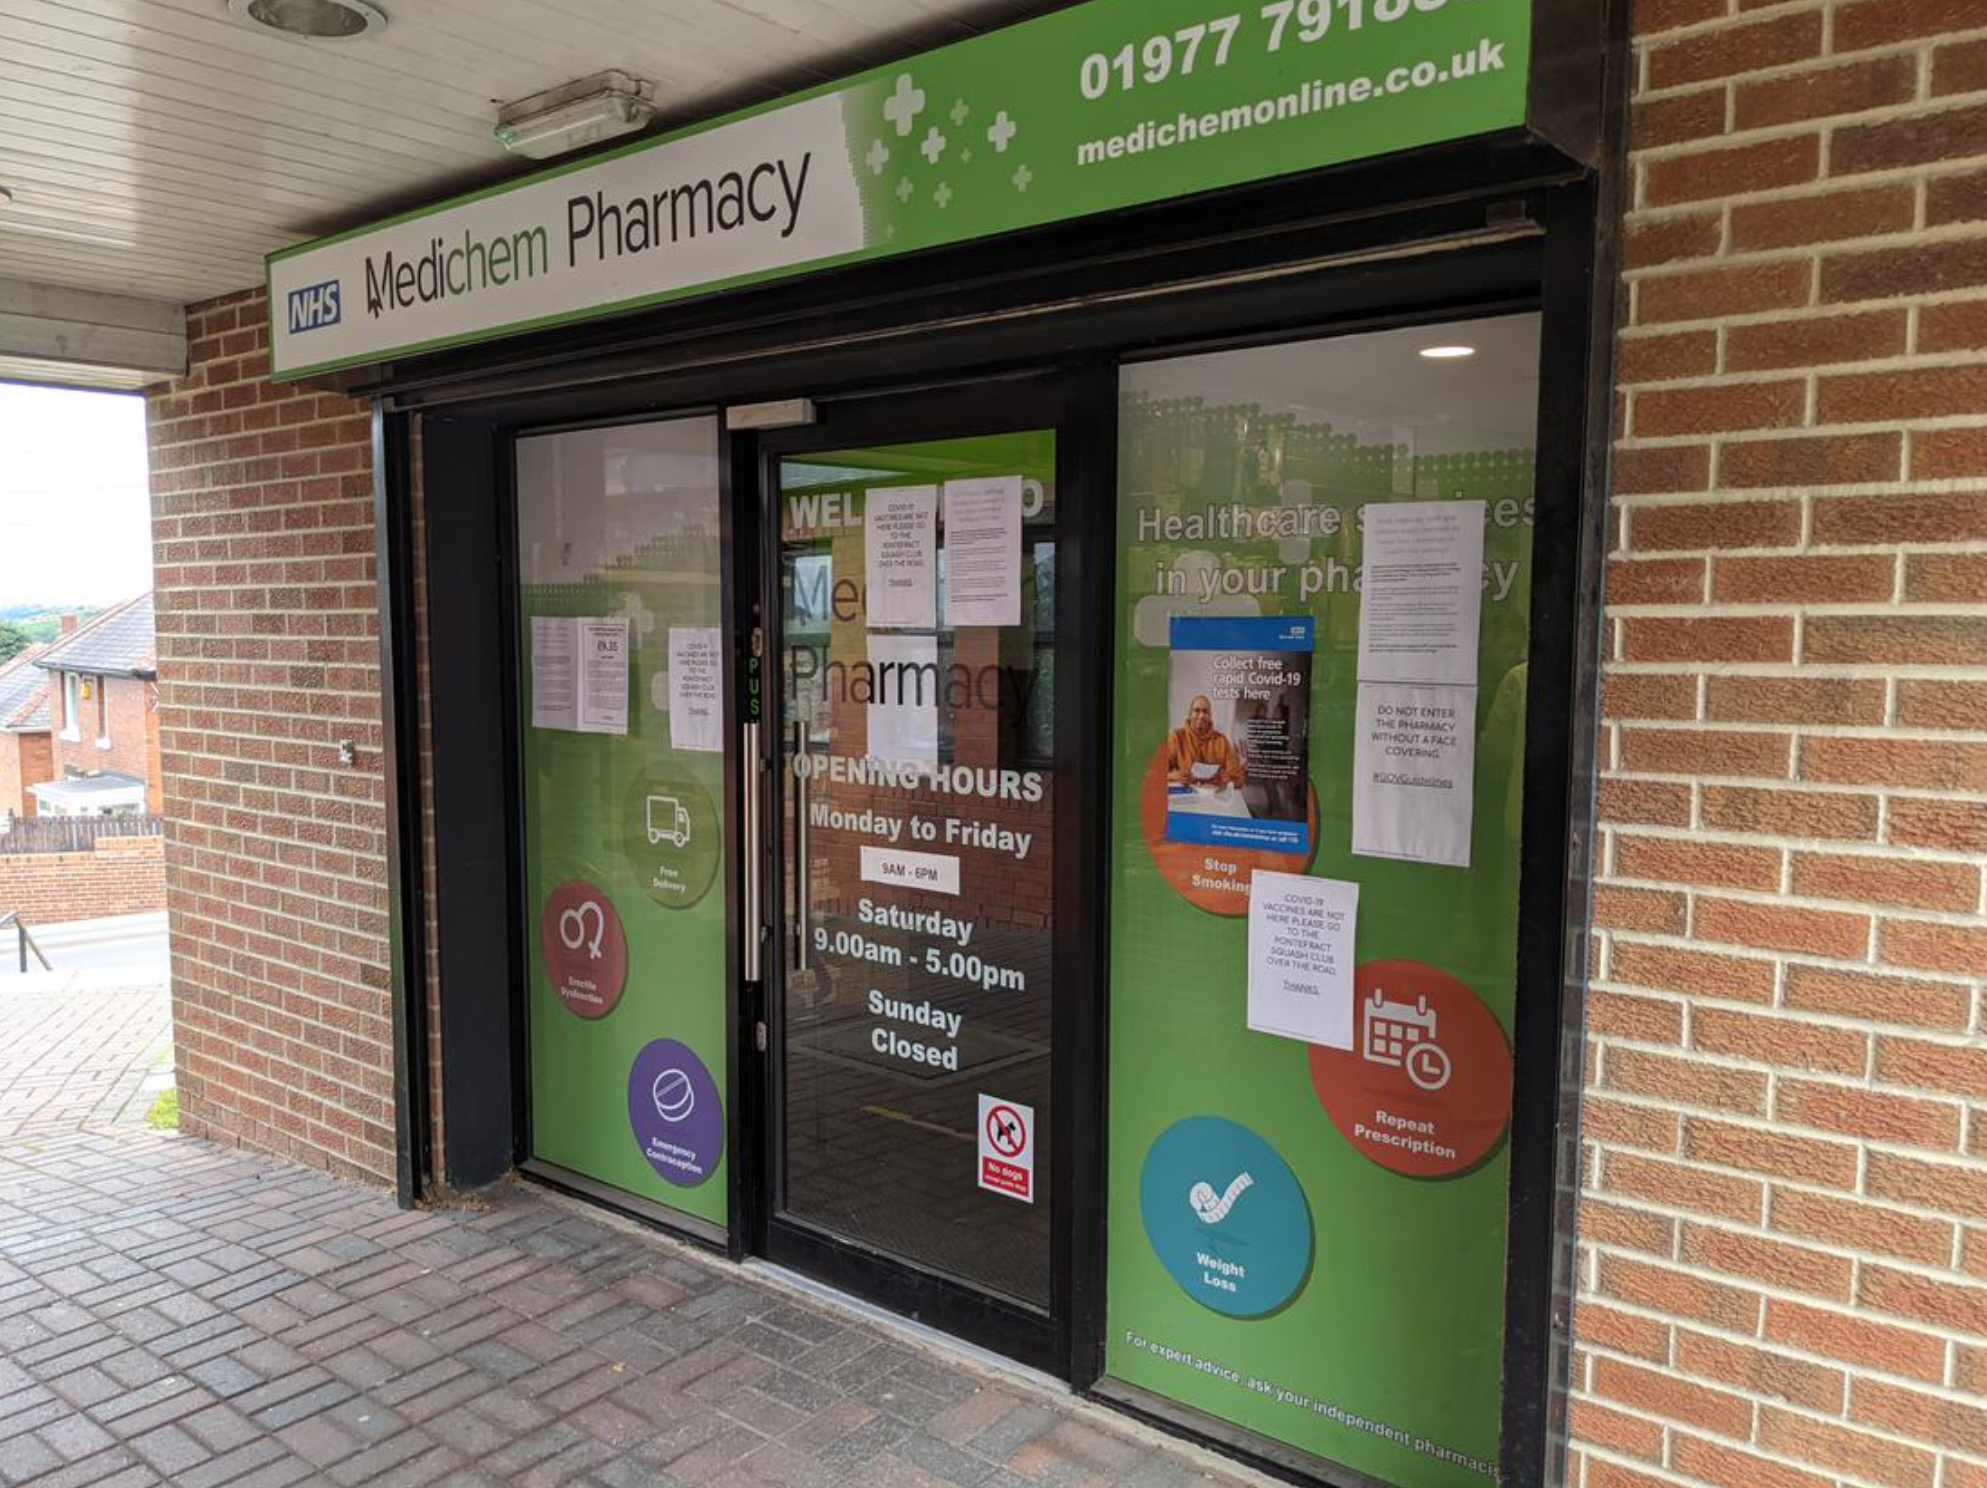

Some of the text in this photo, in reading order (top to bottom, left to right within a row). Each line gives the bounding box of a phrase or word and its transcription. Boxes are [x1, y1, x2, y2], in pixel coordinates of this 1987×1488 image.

[1080, 14, 1241, 100] 01977
[1077, 37, 1505, 165] medichemonline.co.uk
[365, 152, 812, 318] Medichem Pharmacy
[289, 285, 340, 331] NHS
[1137, 506, 1342, 543] Healthcare
[1156, 561, 1186, 596] in
[1200, 564, 1287, 604] your
[1213, 656, 1282, 671] Collect free
[1213, 671, 1301, 687] rapid Covid-19
[791, 644, 1039, 729] Pharmacy
[1213, 685, 1271, 701] tests here
[1376, 718, 1395, 730] THE
[1378, 704, 1455, 719] DO NOT ENTER
[930, 765, 1044, 803] HOURS
[810, 803, 1032, 860] Monday to Friday
[653, 876, 687, 894] Delivery
[659, 865, 678, 879] Free
[882, 862, 906, 877] 9AM
[915, 867, 938, 882] 6PM
[1204, 857, 1237, 876] Stop
[859, 898, 973, 947] Saturday
[814, 927, 902, 967] 9.00am
[926, 948, 1026, 992] 5.00pm
[868, 989, 962, 1038] Sunday
[871, 1028, 959, 1072] Closed
[1354, 1122, 1457, 1160] Prescription
[1376, 1109, 1435, 1136] Repeat
[646, 1147, 703, 1175] Contraception
[652, 1136, 697, 1161] Emergency
[1196, 1250, 1247, 1279] Weight
[1203, 1271, 1237, 1293] Loss
[1126, 1330, 1147, 1348] For
[1149, 1342, 1193, 1366] expert
[1247, 1378, 1273, 1395] ask
[1276, 1387, 1310, 1409] your
[1313, 1400, 1411, 1446] independent
[1414, 1437, 1501, 1478] pharmacis
